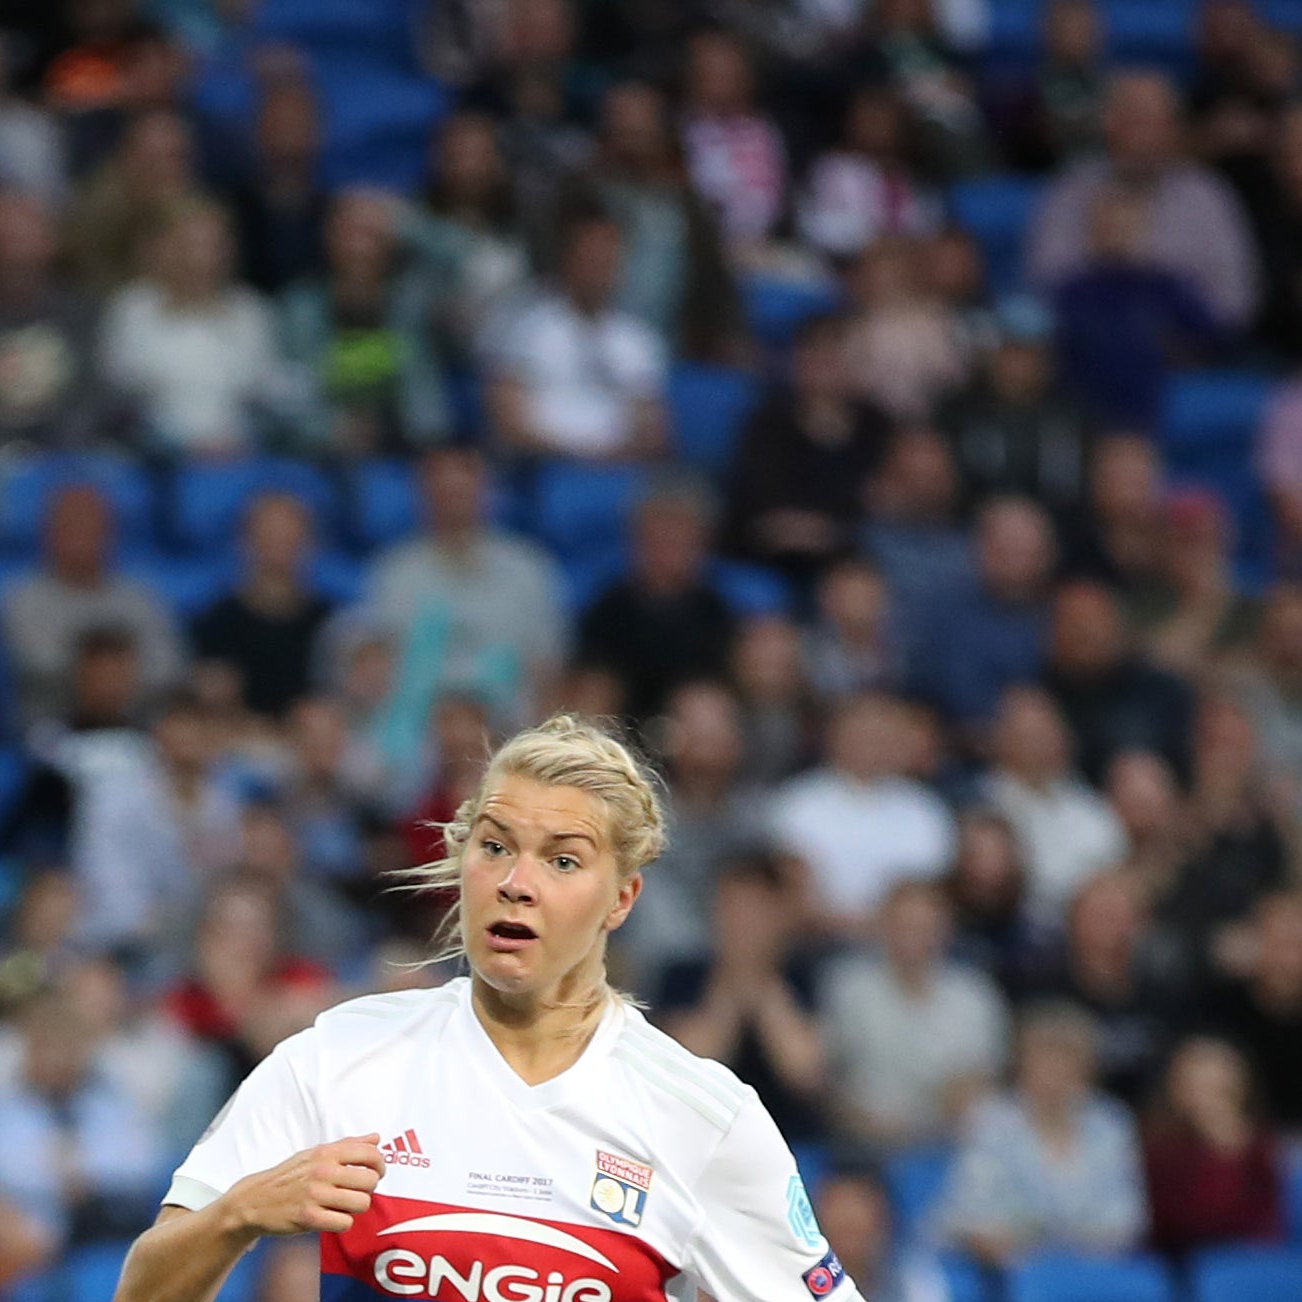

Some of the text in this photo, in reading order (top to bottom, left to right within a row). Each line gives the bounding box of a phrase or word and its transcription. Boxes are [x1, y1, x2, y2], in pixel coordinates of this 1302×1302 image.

[381, 1150, 431, 1168] didas
[598, 1152, 652, 1179] OLYMPIQUE
[468, 1171, 554, 1187] FINAL CARDIFF 2017
[598, 1161, 650, 1187] LYONNAIS
[593, 1178, 642, 1225] OL
